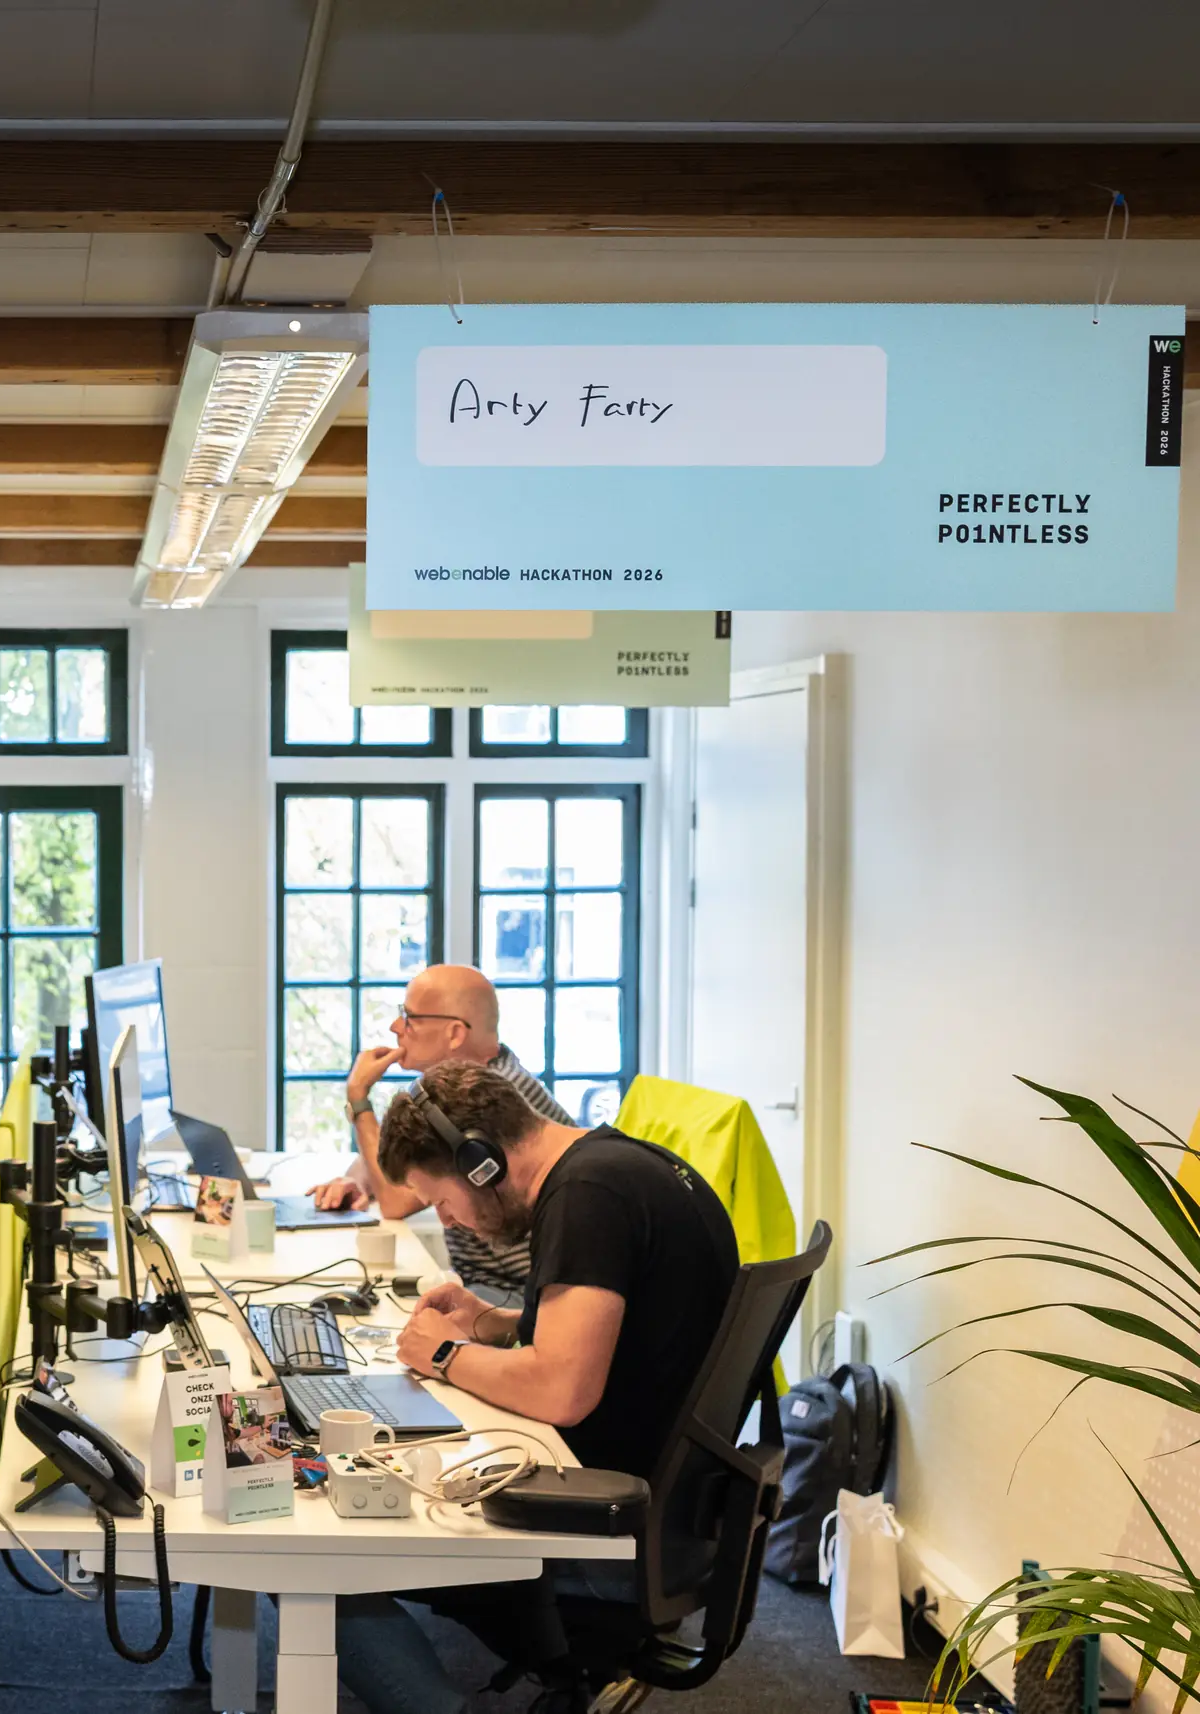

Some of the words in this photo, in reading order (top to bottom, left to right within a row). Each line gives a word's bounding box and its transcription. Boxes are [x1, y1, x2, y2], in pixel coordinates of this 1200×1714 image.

[1154, 340, 1181, 353] we
[450, 378, 548, 426] Arty
[579, 383, 673, 427] Farty
[1161, 366, 1171, 424] HACKATHON
[1160, 430, 1169, 456] 2026
[939, 493, 1091, 514] PERFECTLY
[414, 566, 511, 582] webenable
[520, 569, 613, 582] HACKATHON
[623, 568, 664, 582] 2026
[617, 651, 689, 662] PERFECTLY
[185, 1382, 215, 1393] CHECK
[190, 1394, 213, 1404] ONZE
